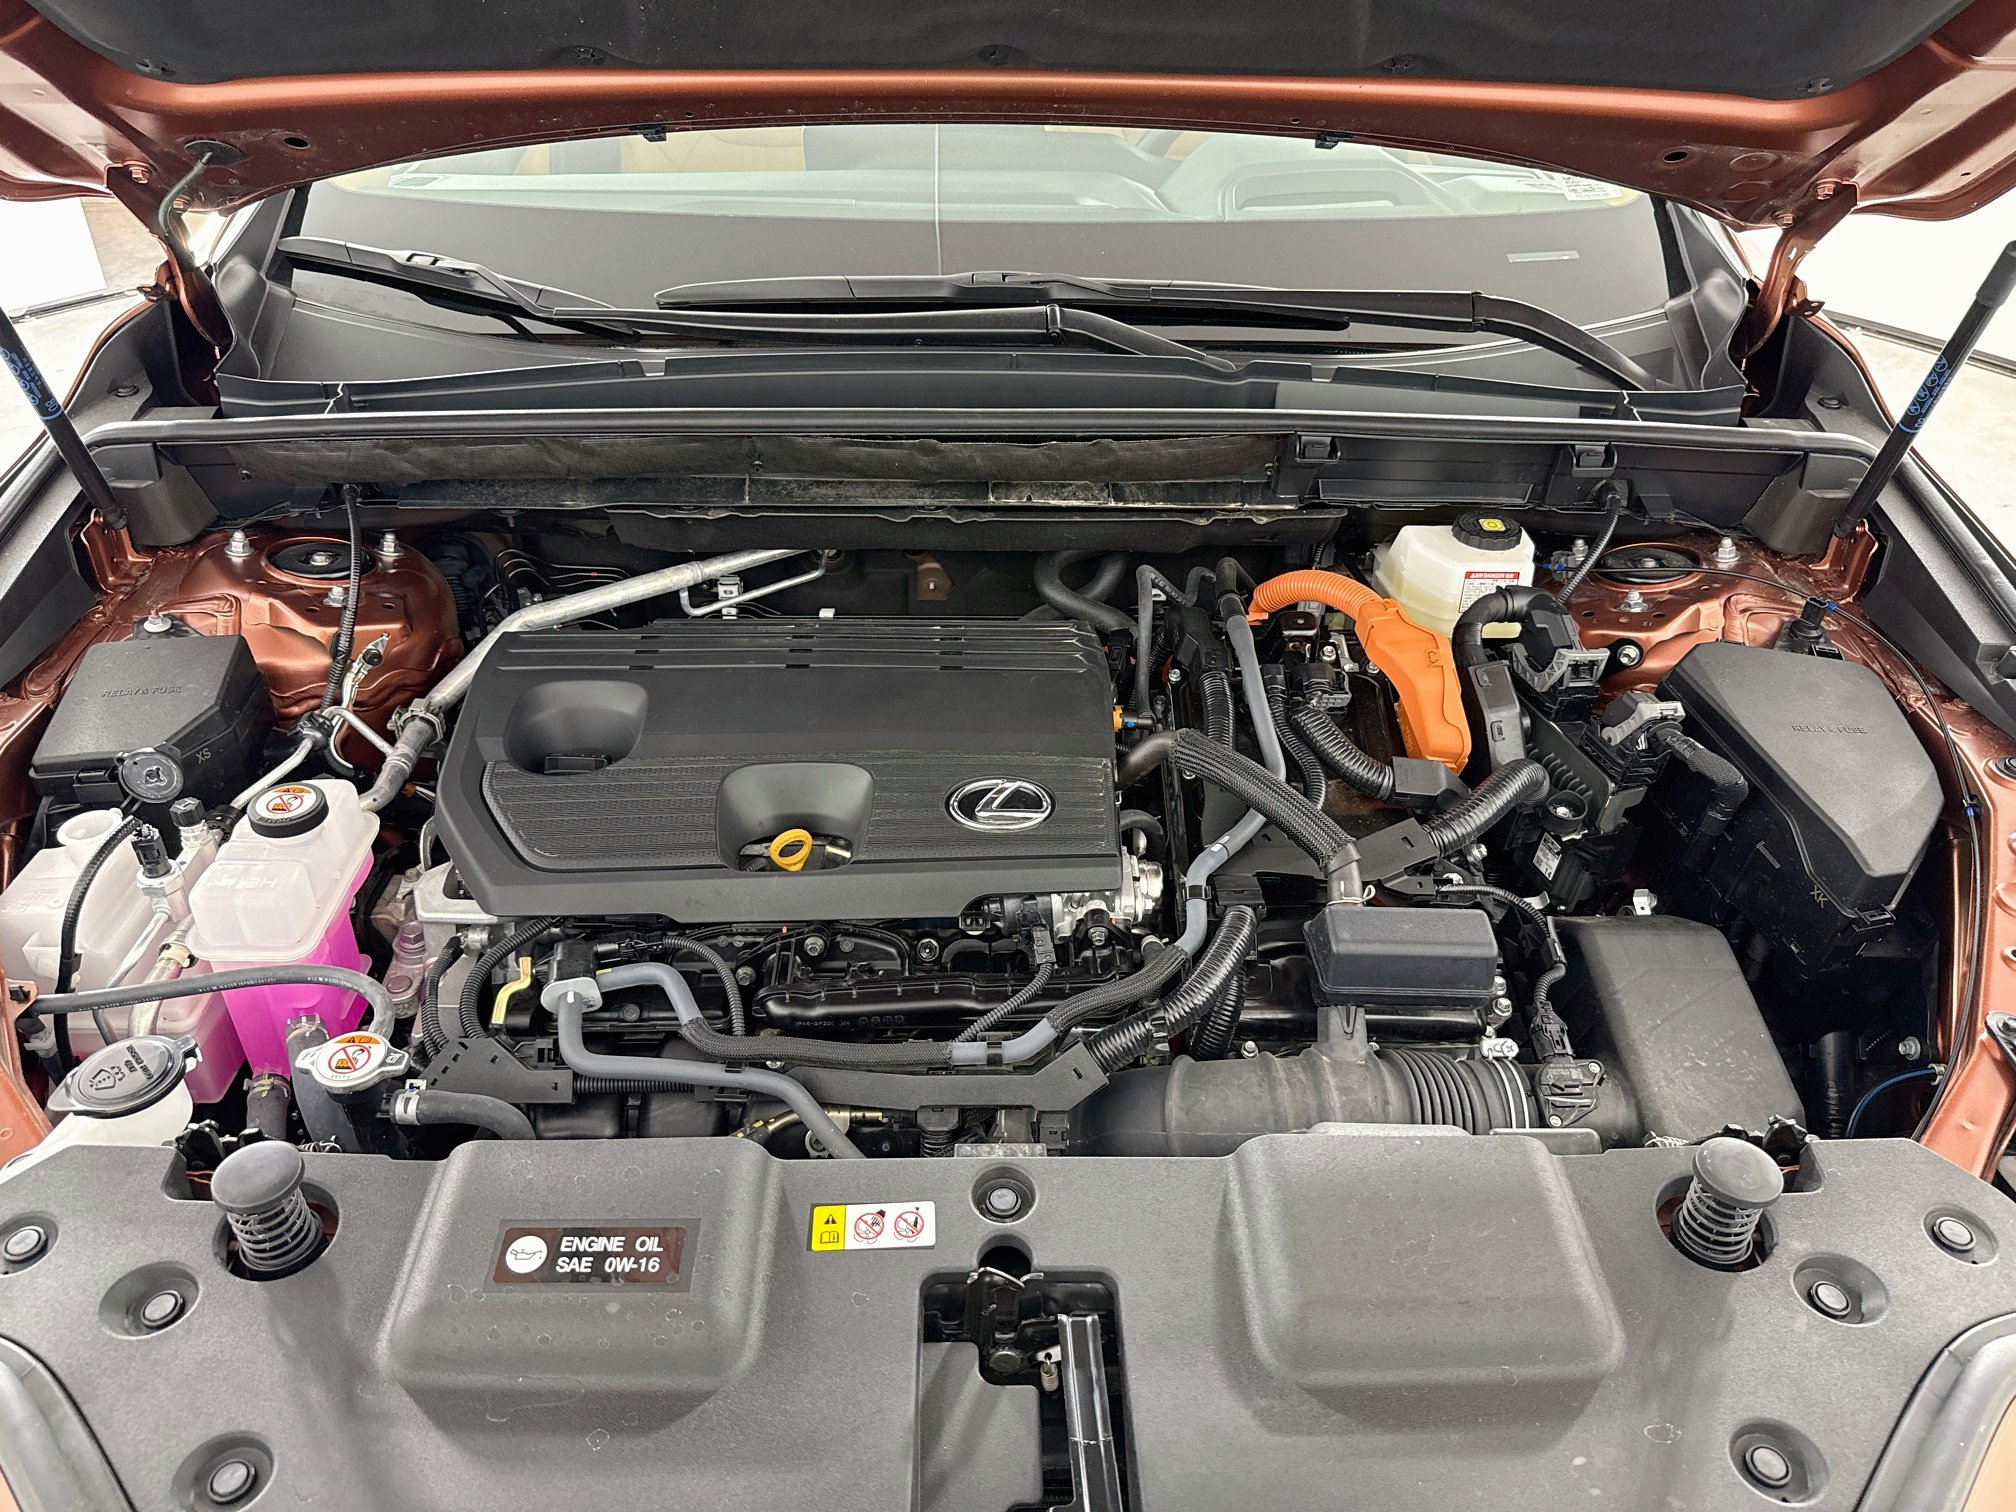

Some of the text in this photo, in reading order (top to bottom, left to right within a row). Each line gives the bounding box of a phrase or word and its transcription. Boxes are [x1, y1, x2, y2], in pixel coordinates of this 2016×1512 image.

[102, 686, 141, 698] RELAY
[151, 685, 183, 695] FUSE
[1791, 724, 1826, 733] RELAY
[1837, 726, 1867, 734] FUSE
[195, 747, 212, 764] XS
[1809, 884, 1829, 909] XK
[559, 1236, 664, 1252] ENGINE OIL
[555, 1257, 660, 1273] SAE 0W-16
